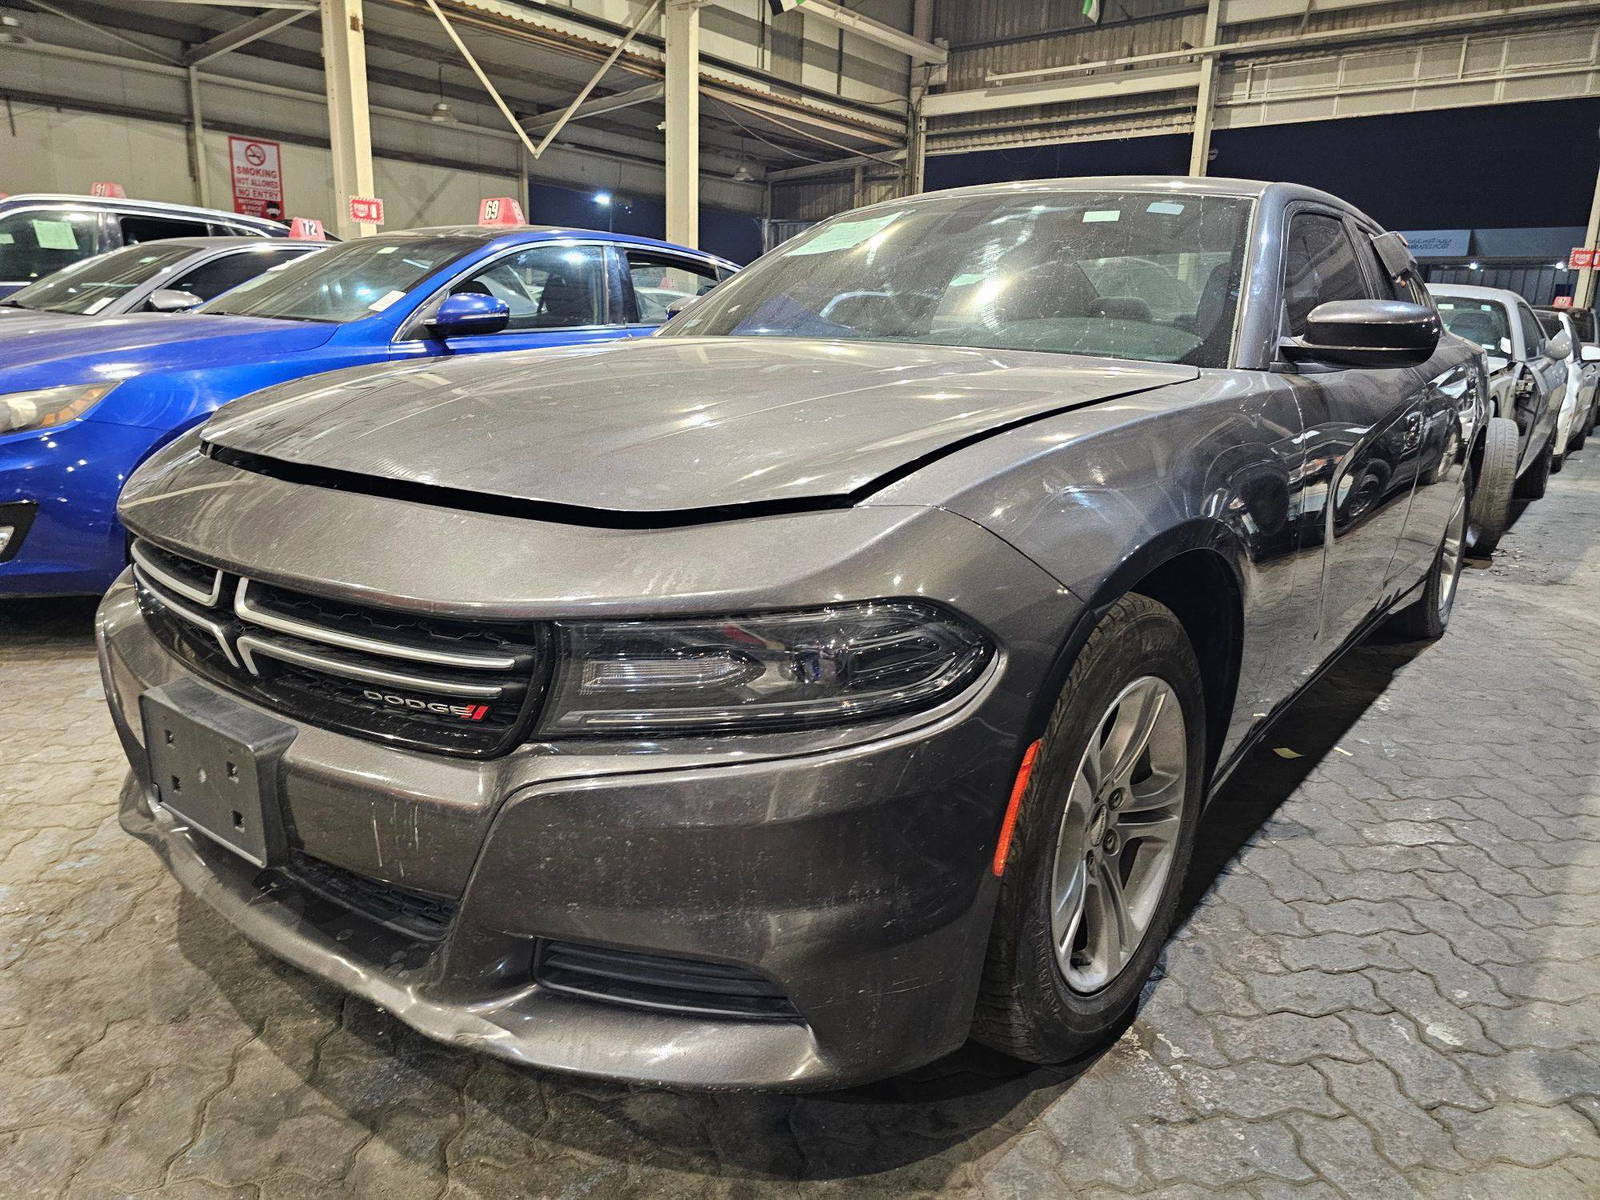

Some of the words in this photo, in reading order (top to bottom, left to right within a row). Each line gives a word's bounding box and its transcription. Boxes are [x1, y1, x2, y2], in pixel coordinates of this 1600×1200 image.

[236, 166, 278, 179] SMOKING
[238, 188, 250, 197] NO
[252, 190, 279, 201] ENTRY
[485, 200, 499, 220] 69
[303, 220, 317, 236] 72
[363, 689, 473, 716] DODGE
